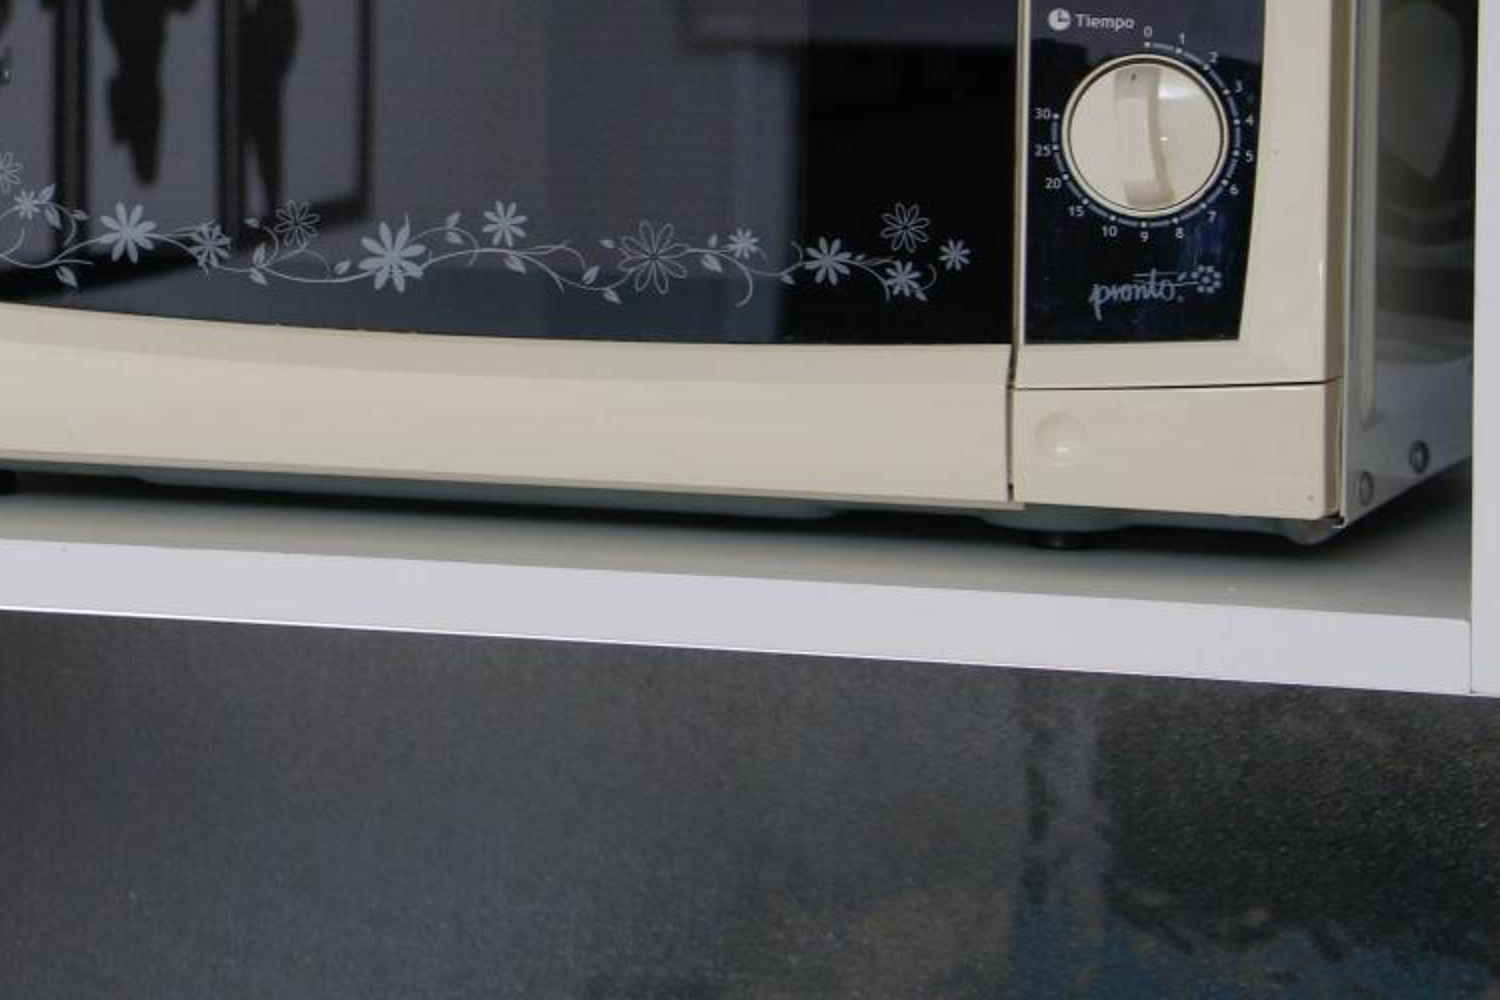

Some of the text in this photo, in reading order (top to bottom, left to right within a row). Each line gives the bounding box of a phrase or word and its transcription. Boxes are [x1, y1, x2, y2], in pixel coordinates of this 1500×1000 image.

[1075, 13, 1135, 32] Tiempo
[1143, 26, 1152, 38] 0
[1178, 34, 1185, 45] 1
[1209, 52, 1218, 63] 2
[1235, 81, 1243, 92] 3
[1034, 108, 1051, 120] 30
[1245, 115, 1254, 126] 4
[1034, 146, 1051, 157] 25
[1245, 152, 1253, 163] 5
[1044, 178, 1062, 189] 20
[1230, 184, 1239, 196] 6
[1068, 206, 1085, 217] 15
[1208, 211, 1216, 222] 7
[1102, 226, 1118, 238] 10
[1140, 231, 1149, 242] 9
[1175, 228, 1184, 239] 8
[1088, 268, 1177, 321] pronto
